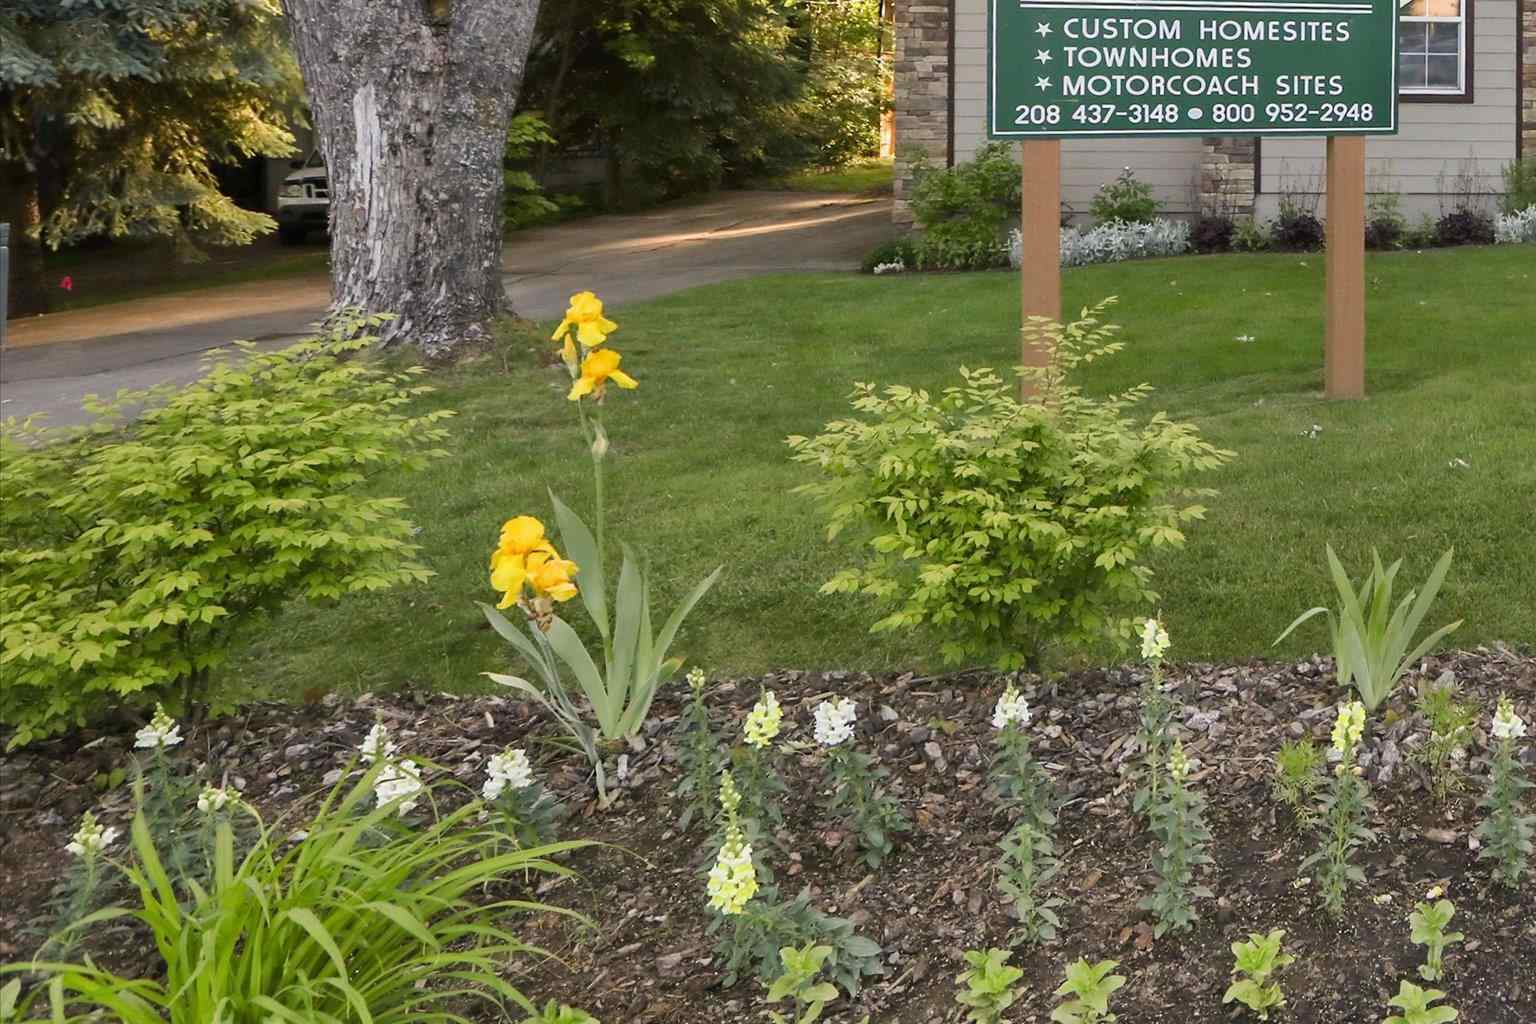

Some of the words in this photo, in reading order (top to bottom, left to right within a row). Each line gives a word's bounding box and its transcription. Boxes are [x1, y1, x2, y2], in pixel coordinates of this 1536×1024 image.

[1063, 18, 1181, 40] CUSTOM
[1200, 19, 1350, 42] HOMESITES
[1063, 46, 1251, 68] TOWNHOMES
[1062, 75, 1259, 96] MOTORCOACH
[1276, 75, 1343, 96] SITES
[1014, 104, 1061, 125] 208
[1072, 103, 1179, 124] 437-3148
[1212, 103, 1255, 123] 800
[1265, 103, 1374, 123] 952-2948
